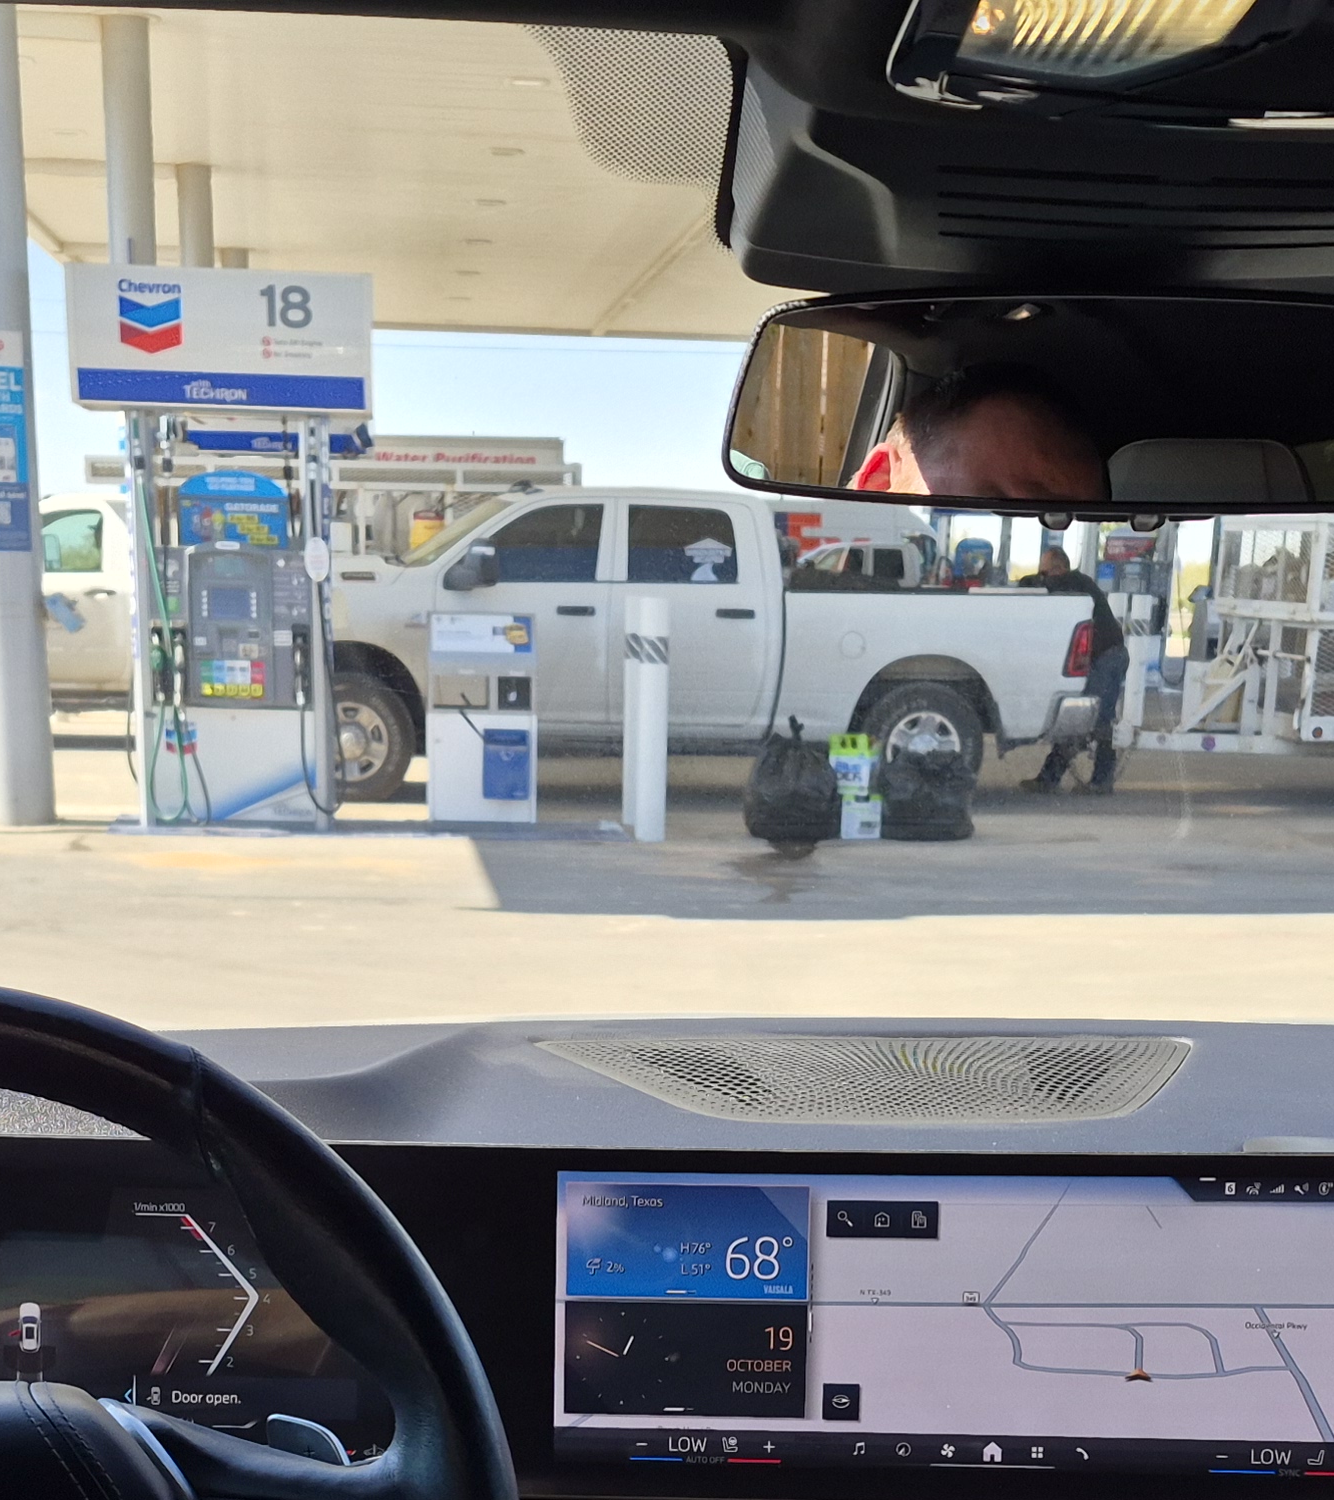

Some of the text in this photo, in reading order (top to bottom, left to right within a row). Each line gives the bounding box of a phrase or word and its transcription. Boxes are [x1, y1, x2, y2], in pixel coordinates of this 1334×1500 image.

[118, 278, 182, 295] Chevron
[260, 283, 314, 329] 18
[183, 384, 247, 402] TECHRON
[374, 452, 429, 463] Water
[134, 1202, 186, 1213] 1/min x1000
[582, 1195, 663, 1209] Midland, Texas
[208, 1222, 216, 1233] 7
[227, 1244, 235, 1255] 6
[725, 1236, 794, 1281] 68°
[249, 1268, 257, 1279] 5
[606, 1262, 625, 1274] 2%
[763, 1284, 794, 1294] VAISALA
[263, 1293, 271, 1304] 4
[247, 1325, 255, 1336] 3
[765, 1326, 794, 1351] 19
[227, 1356, 234, 1367] 2
[726, 1358, 793, 1373] OCTOBER
[732, 1381, 791, 1394] MONDAY
[171, 1390, 242, 1407] Door open.
[668, 1436, 707, 1453] LOW
[686, 1456, 725, 1465] AUTO OFF
[1250, 1448, 1292, 1466] LOW
[1278, 1468, 1301, 1478] SYNC
